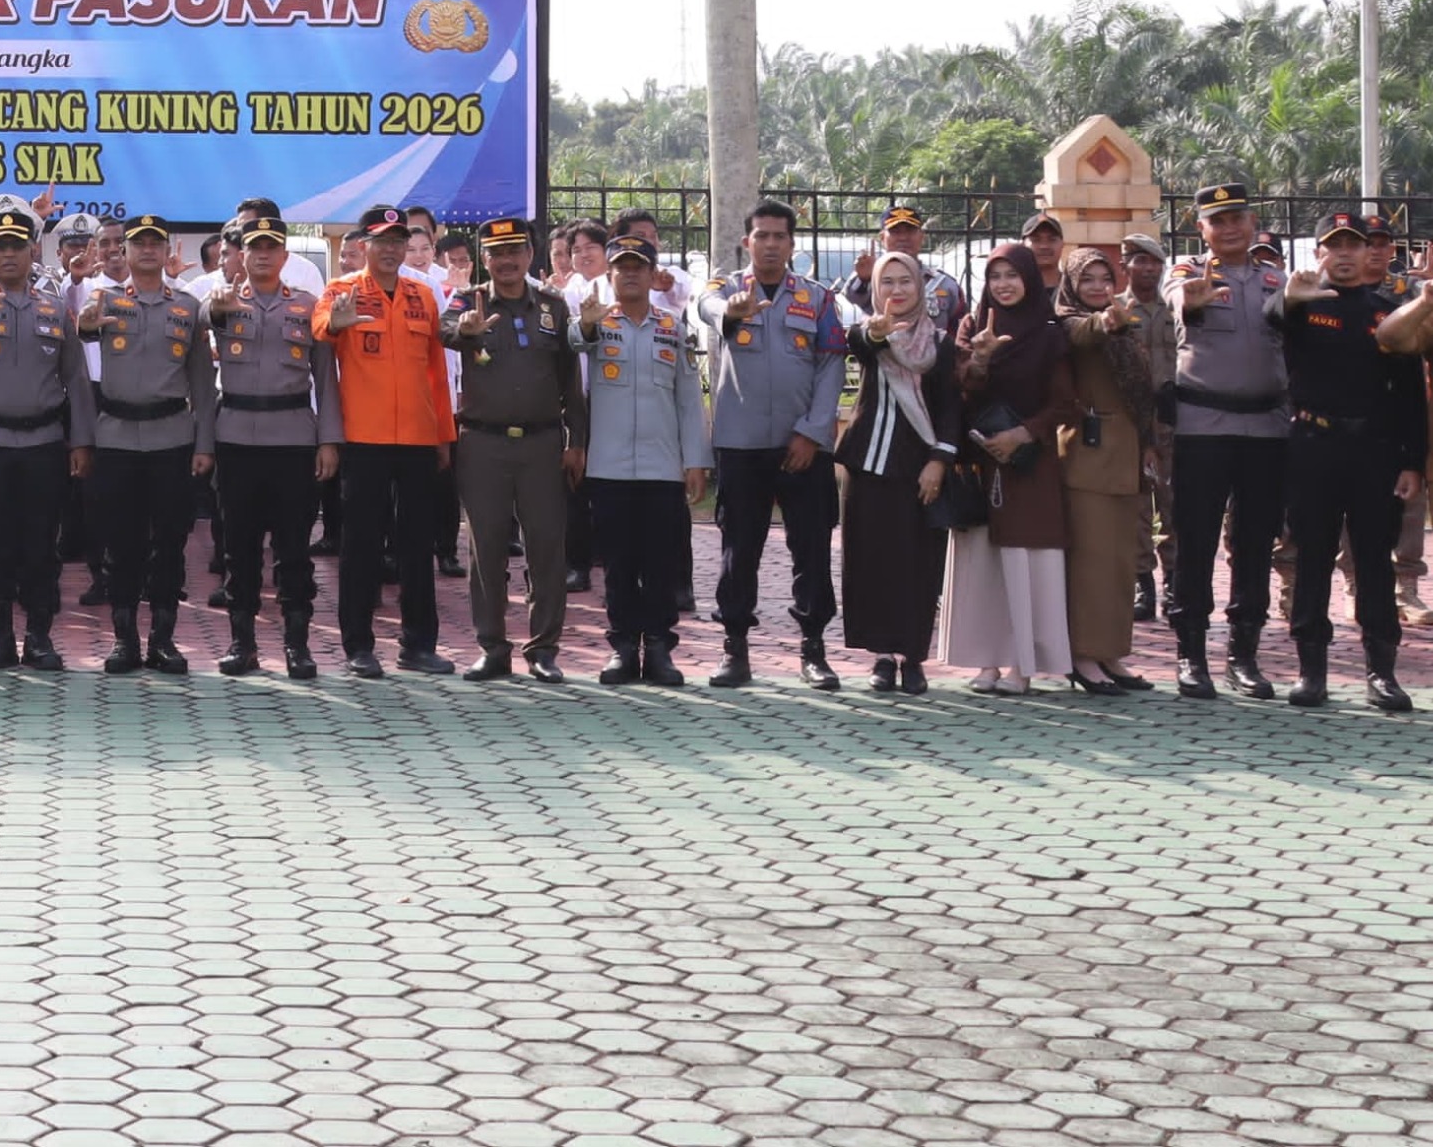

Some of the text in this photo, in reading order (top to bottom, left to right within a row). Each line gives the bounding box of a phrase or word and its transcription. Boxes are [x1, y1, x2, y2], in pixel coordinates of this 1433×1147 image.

[96, 90, 239, 134] KUNING
[248, 91, 371, 135] TAHUN
[380, 92, 484, 135] 2026
[14, 141, 104, 185] SIAK
[74, 201, 127, 218] 2026
